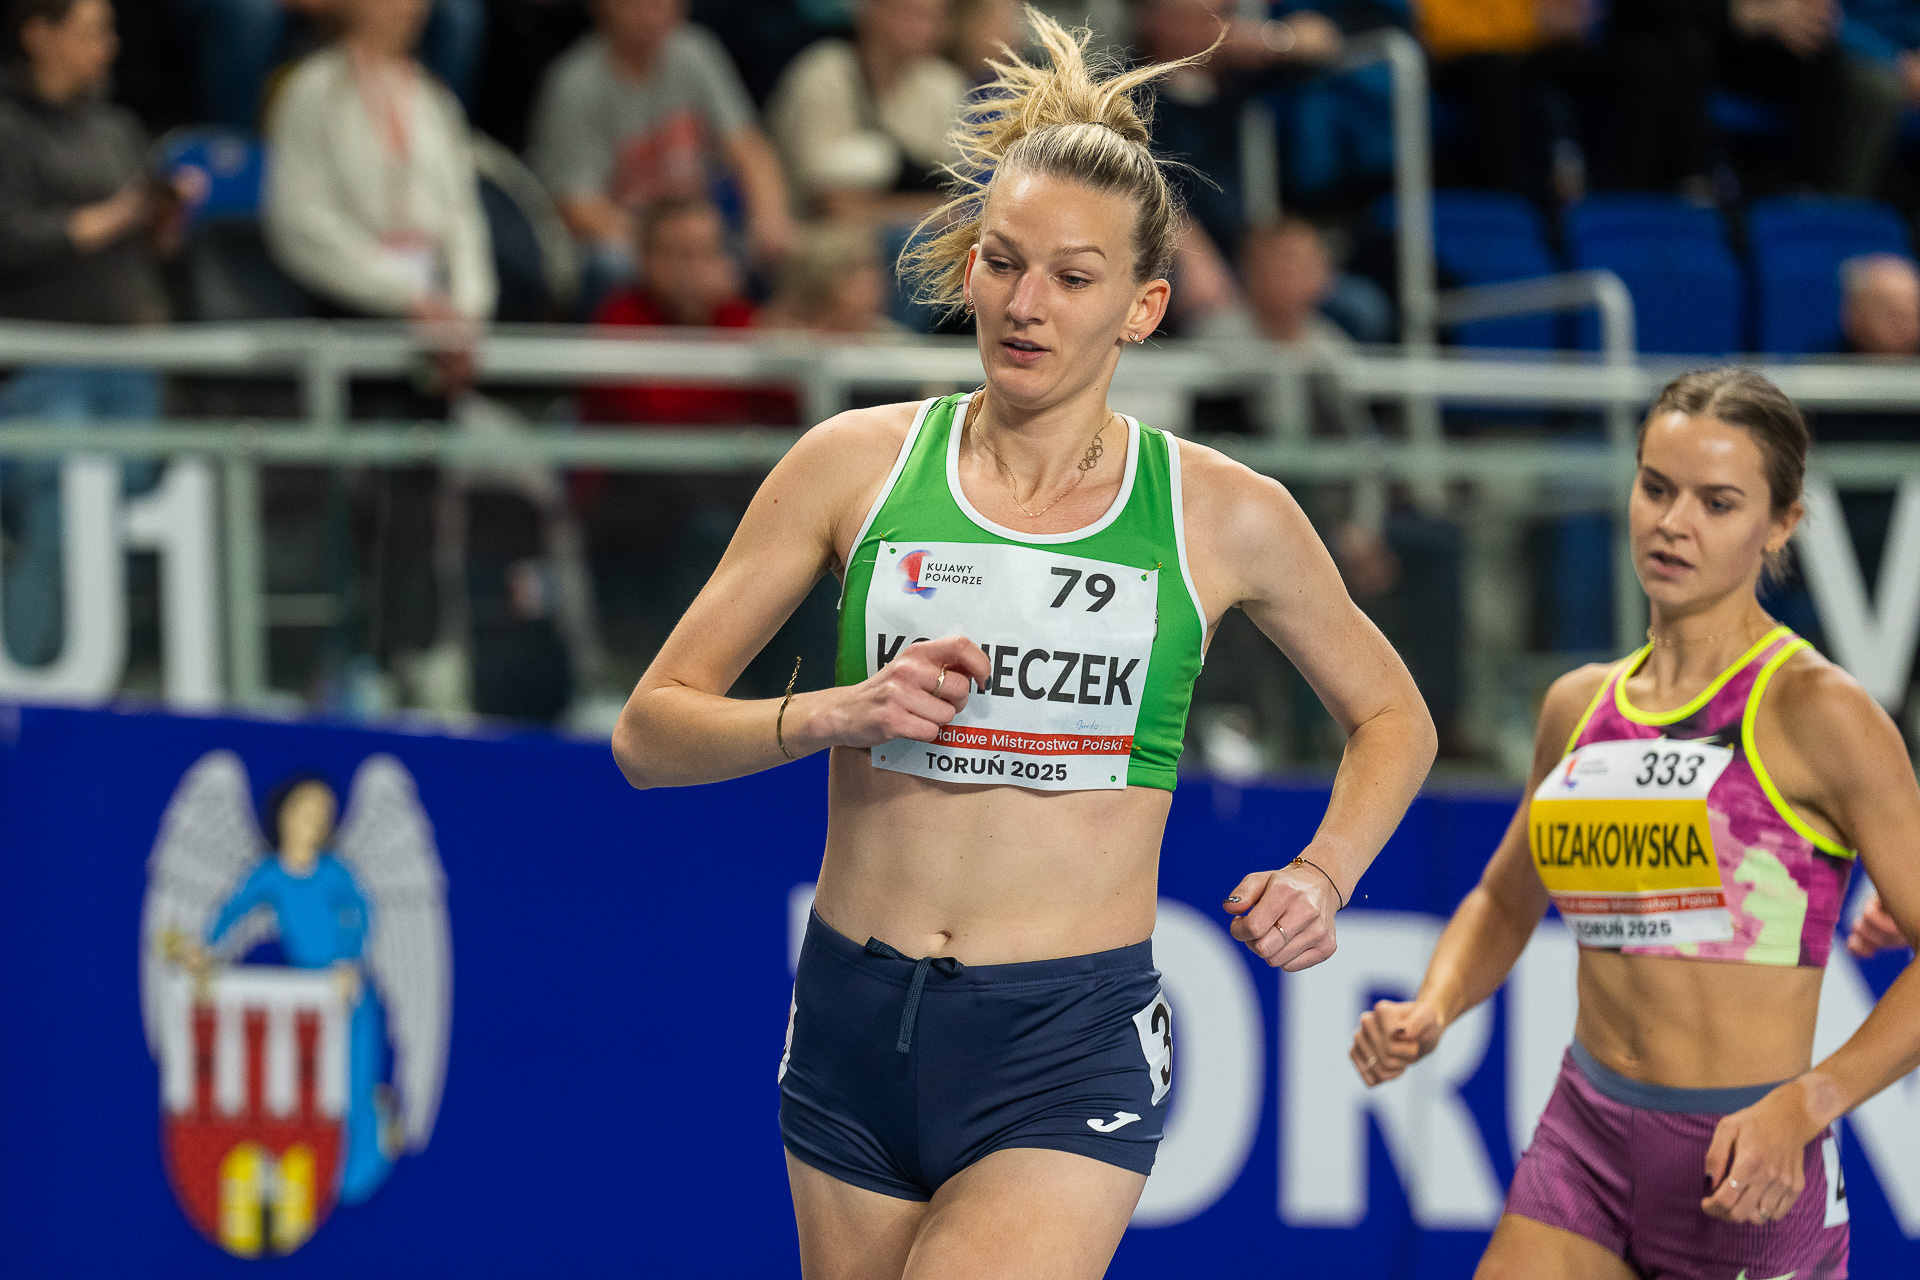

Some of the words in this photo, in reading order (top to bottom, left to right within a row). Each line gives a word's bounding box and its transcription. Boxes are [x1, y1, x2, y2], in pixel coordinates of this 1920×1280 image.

[925, 572, 983, 585] POMORZE
[926, 562, 974, 574] KUJAWY
[1050, 566, 1116, 613] 79
[877, 633, 1140, 706] KECZEK
[991, 734, 1079, 751] Mistrzostwa
[1082, 738, 1124, 752] Polski
[926, 752, 1005, 776] TORUŃ
[1011, 761, 1067, 781] 2025
[1636, 751, 1705, 786] 333
[1536, 822, 1710, 867] LIZAKOWSKA
[1628, 920, 1671, 938] 2025
[1150, 1003, 1171, 1086] 3
